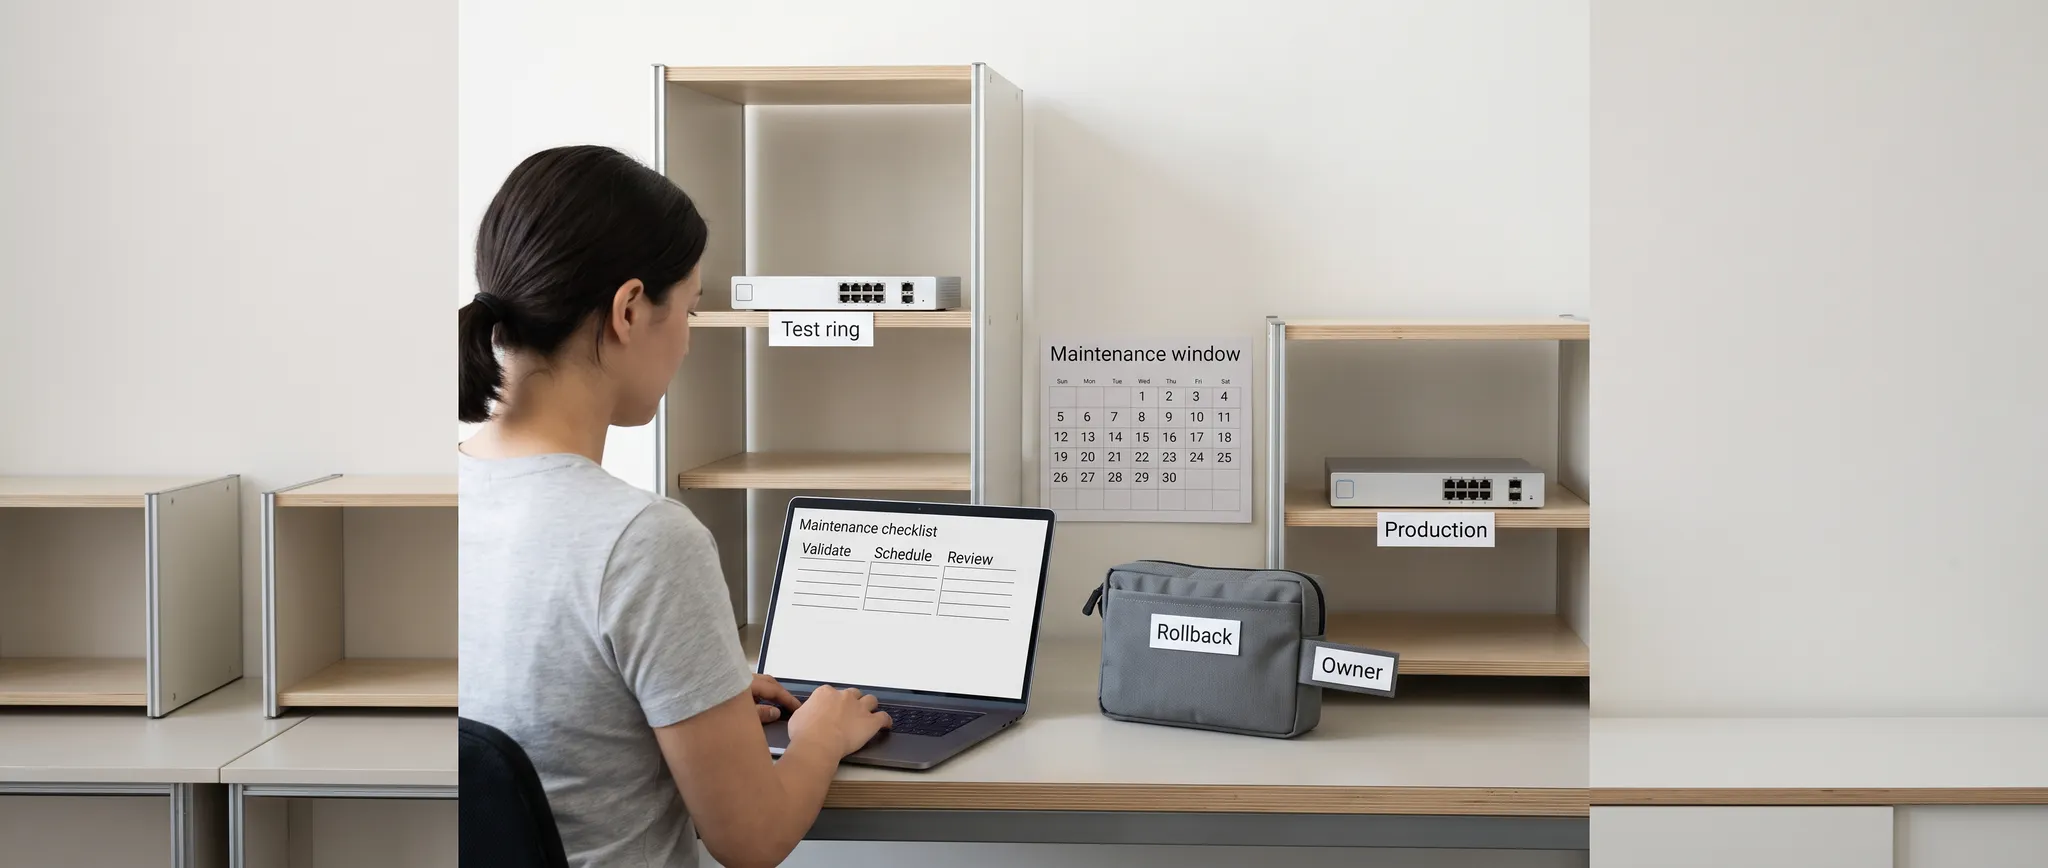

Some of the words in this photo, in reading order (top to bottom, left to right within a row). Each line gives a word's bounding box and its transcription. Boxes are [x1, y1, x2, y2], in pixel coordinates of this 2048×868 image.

[781, 321, 820, 337] Test
[827, 321, 859, 341] ring
[1051, 346, 1166, 361] Maintenance
[1172, 345, 1240, 361] window
[1139, 391, 1145, 401] 1
[1165, 391, 1173, 401] 2
[1192, 391, 1200, 401] 3
[1220, 392, 1229, 401] 4
[1057, 412, 1065, 421] 5
[1083, 412, 1091, 422] 6
[1110, 412, 1119, 421] 7
[1138, 412, 1146, 422] 8
[1165, 412, 1173, 422] 9
[1191, 412, 1203, 422] 10
[1218, 412, 1229, 422] 11
[1055, 432, 1068, 442] 12
[1082, 432, 1095, 442] 13
[1109, 432, 1122, 442] 14
[1136, 432, 1149, 442] 15
[1163, 432, 1176, 442] 16
[1190, 432, 1203, 442] 17
[1218, 432, 1231, 442] 18
[1055, 452, 1067, 461] 19
[1081, 452, 1095, 462] 20
[1108, 452, 1120, 462] 21
[1135, 452, 1149, 462] 22
[1163, 452, 1176, 462] 23
[1190, 452, 1204, 462] 24
[1218, 453, 1231, 462] 25
[1054, 472, 1068, 482] 26
[1081, 472, 1095, 482] 27
[1108, 472, 1122, 482] 28
[1135, 472, 1149, 482] 29
[1163, 472, 1176, 482] 30
[800, 519, 878, 534] Maintenance
[882, 523, 937, 537] checklist
[1386, 521, 1487, 538] Production
[802, 543, 851, 557] Validate
[874, 547, 932, 562] Schedule
[948, 551, 993, 565] Review
[1158, 624, 1232, 645] Rollback
[1322, 657, 1383, 680] Owner
